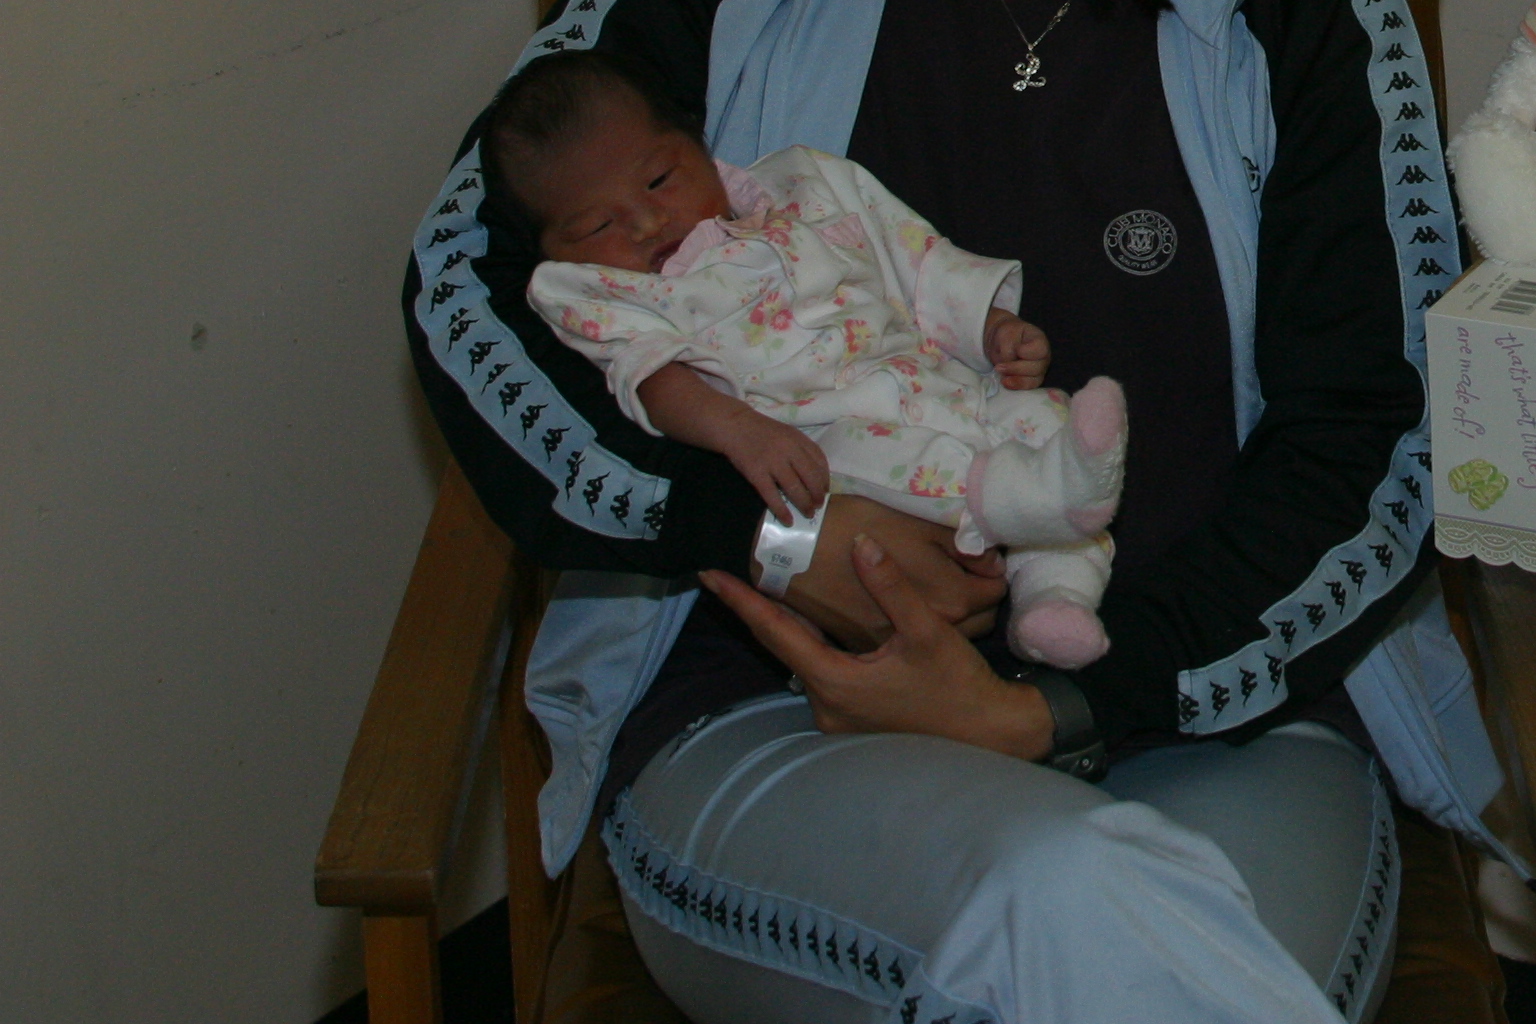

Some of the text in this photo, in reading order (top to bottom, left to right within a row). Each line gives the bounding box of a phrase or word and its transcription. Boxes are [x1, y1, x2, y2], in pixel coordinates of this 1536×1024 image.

[1107, 212, 1175, 255] CLUB MONACO
[1456, 326, 1473, 355] are
[1494, 332, 1532, 386] that's
[1454, 359, 1481, 405] made
